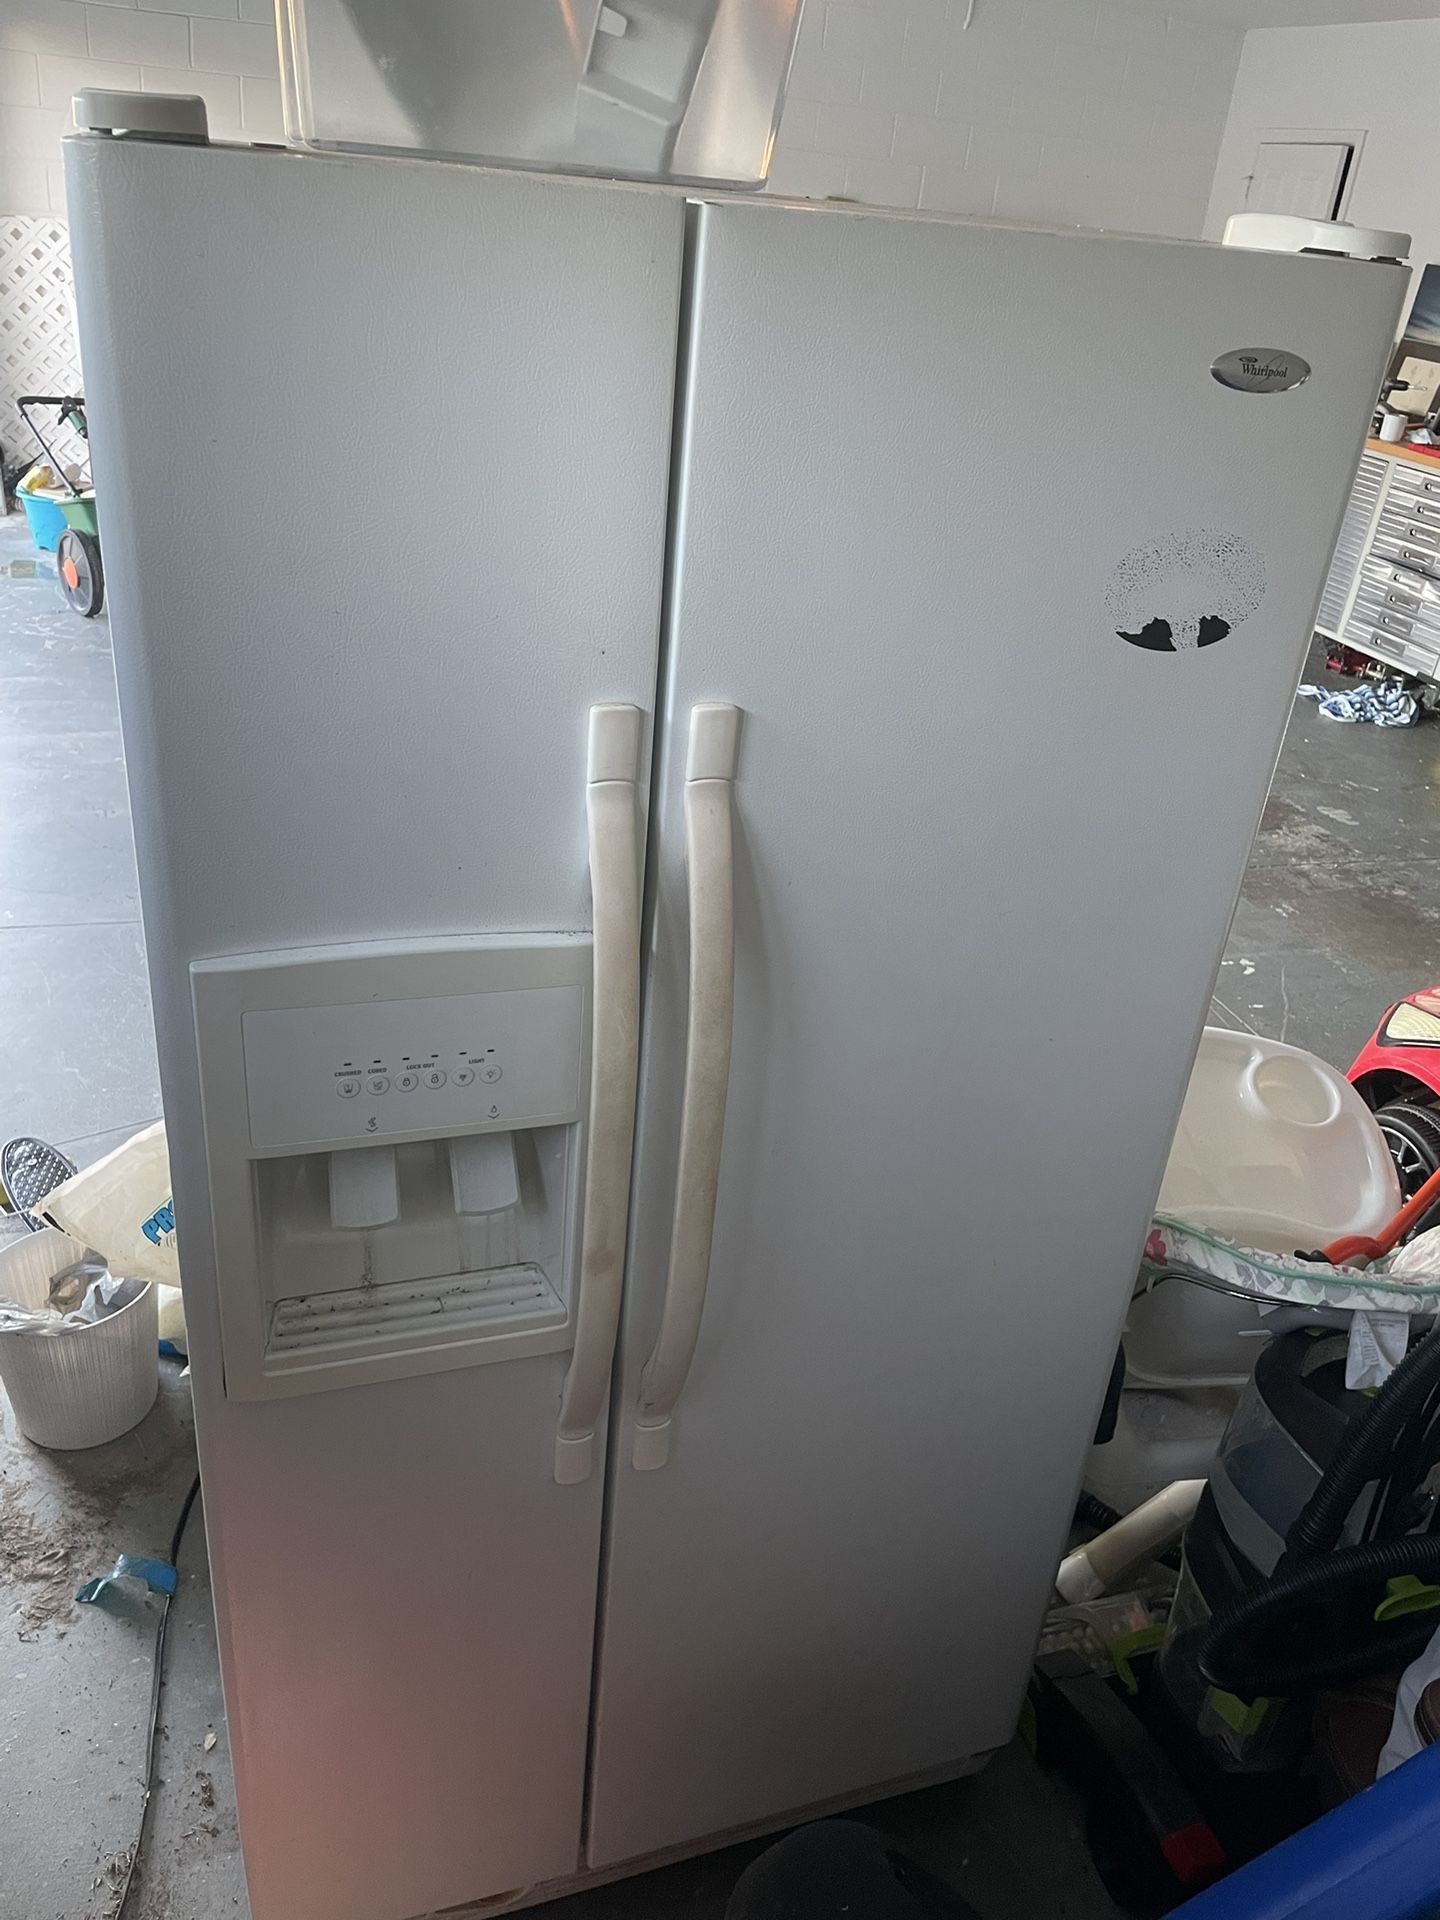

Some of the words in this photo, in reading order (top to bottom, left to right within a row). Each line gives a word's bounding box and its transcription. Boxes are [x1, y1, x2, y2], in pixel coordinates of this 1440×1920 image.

[1241, 363, 1288, 380] Whirlpool
[468, 1057, 485, 1065] LIGHT
[406, 1063, 422, 1071] LOCK
[422, 1062, 435, 1070] OUT
[334, 1069, 362, 1077] CRUSHED
[367, 1067, 387, 1075] CUBED
